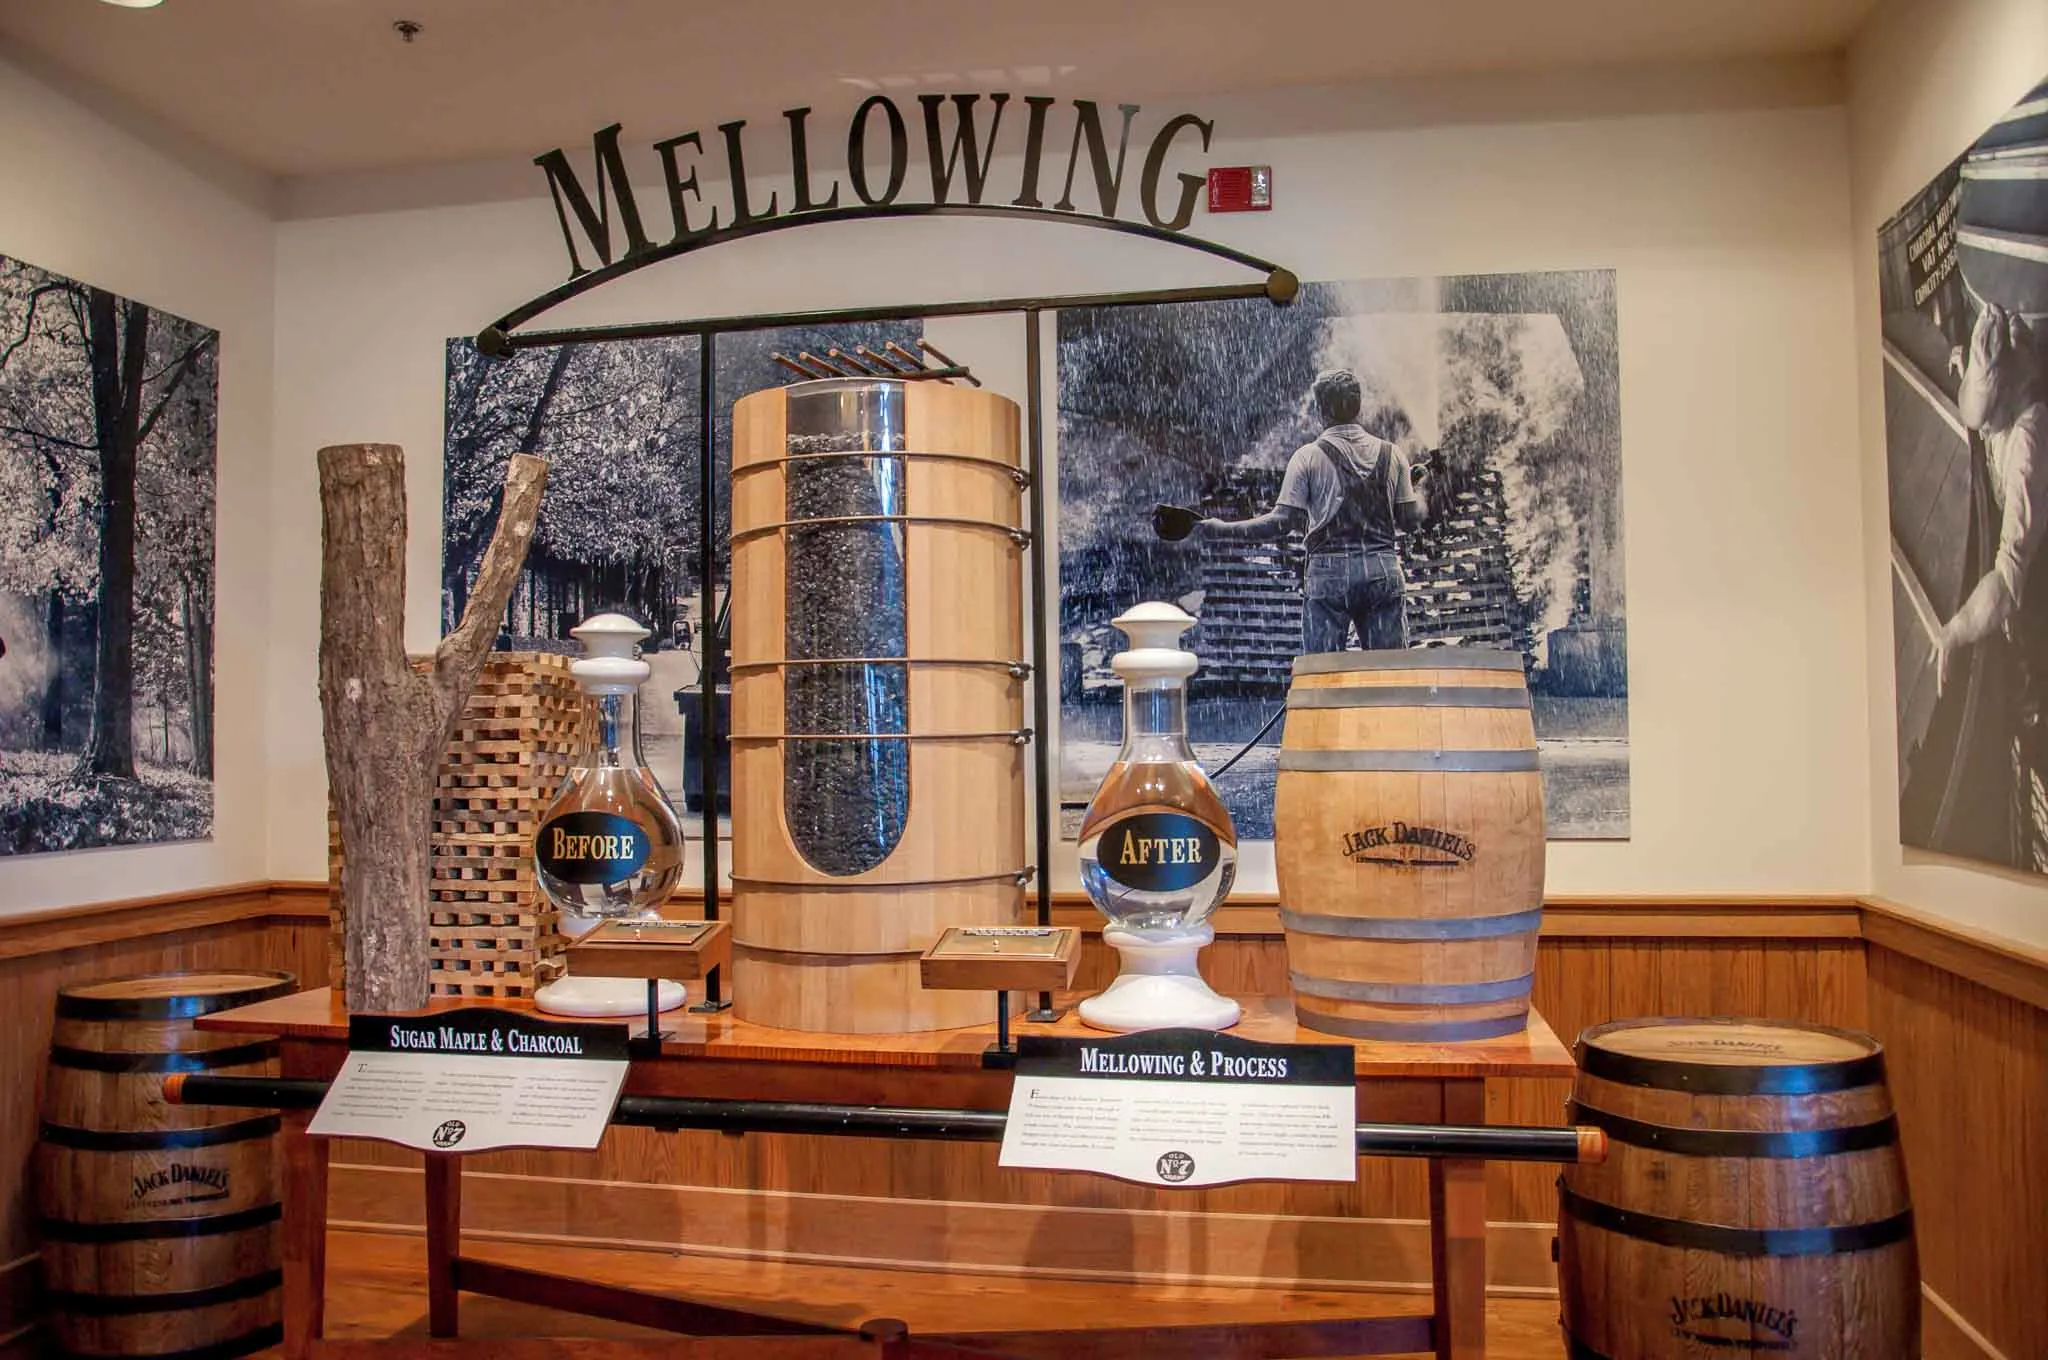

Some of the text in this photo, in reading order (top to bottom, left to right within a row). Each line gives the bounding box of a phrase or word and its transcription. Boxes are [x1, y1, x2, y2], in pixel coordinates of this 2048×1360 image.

[533, 93, 1214, 279] MELLOWING
[1921, 245, 1936, 273] VAT
[552, 827, 635, 860] BEFORE
[1119, 829, 1203, 865] AFTER
[1342, 820, 1476, 861] JACK DANIEL'S
[390, 1024, 583, 1054] SUGAR MAPLE & CHARCOAL
[1080, 1047, 1288, 1078] MELLOWING & PROCESS
[134, 1169, 170, 1199] JACK
